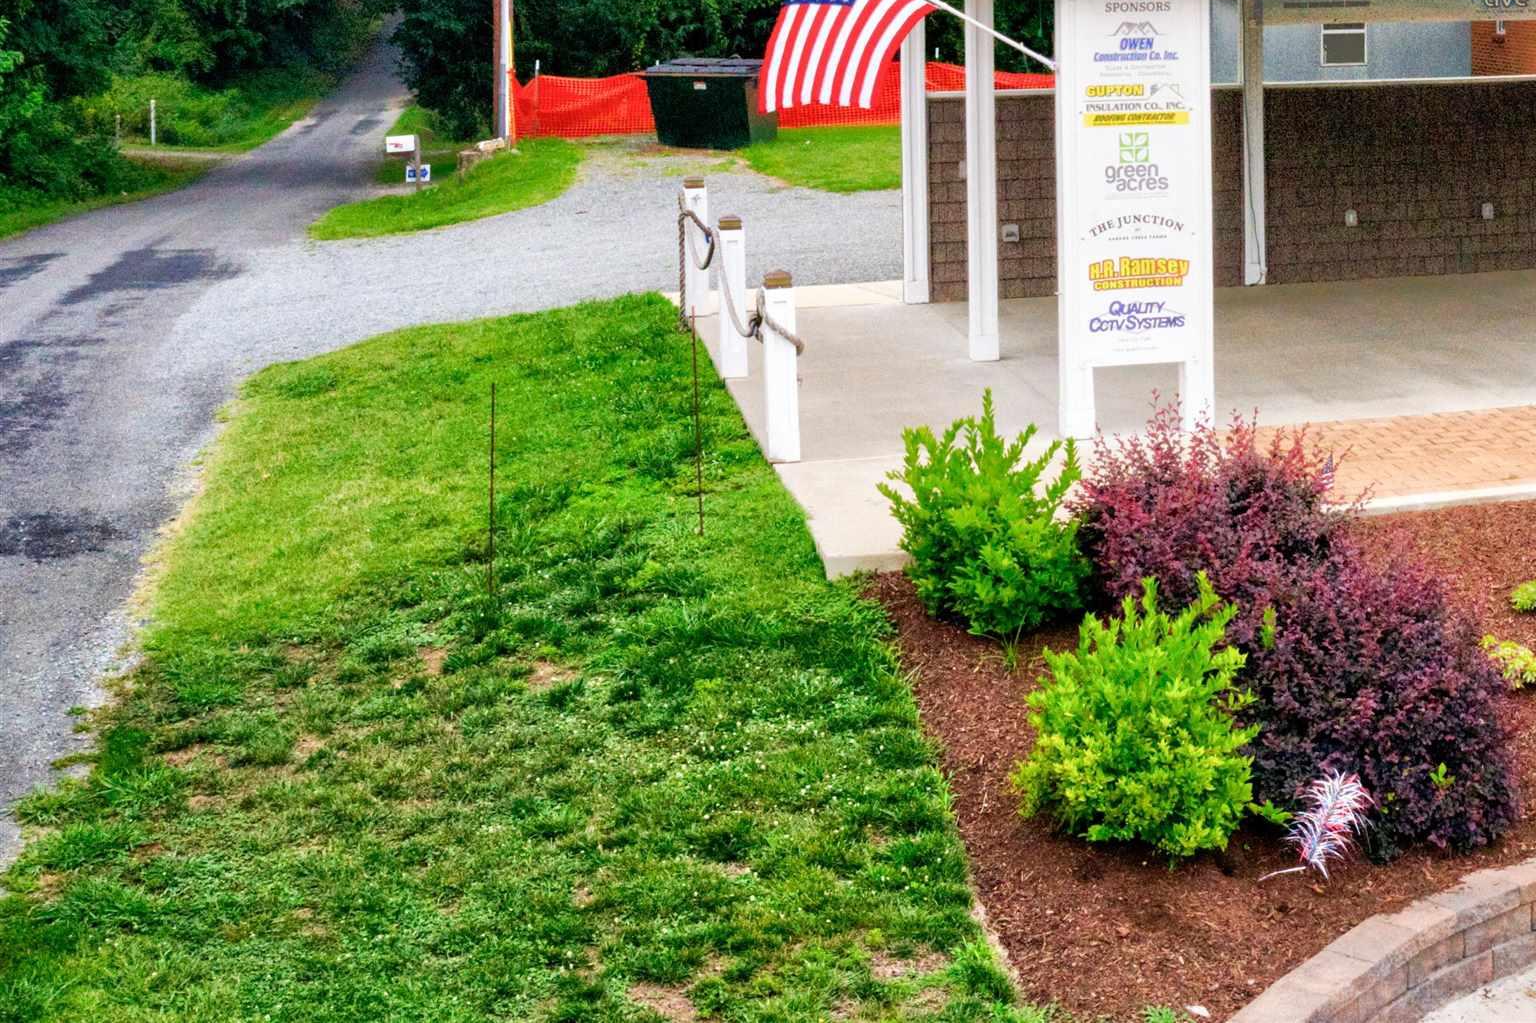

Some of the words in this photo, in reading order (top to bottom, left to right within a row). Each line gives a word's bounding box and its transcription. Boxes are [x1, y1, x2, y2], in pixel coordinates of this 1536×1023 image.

[1105, 1, 1171, 12] SPONSORS
[1120, 38, 1154, 50] OWEN
[1094, 52, 1147, 62] Construction
[1149, 51, 1162, 61] Co.
[1163, 50, 1179, 61] Inc.
[1086, 84, 1144, 97] GUPTON
[1086, 102, 1142, 112] INSULATION
[1166, 101, 1185, 110] INC.
[1105, 164, 1159, 183] green
[1116, 176, 1169, 191] acres
[1089, 219, 1115, 237] THE
[1117, 214, 1185, 232] JUNCTION
[1119, 256, 1190, 278] Ramsey
[1094, 276, 1183, 291] CONSTRUCTION
[1109, 301, 1165, 316] QUALITY
